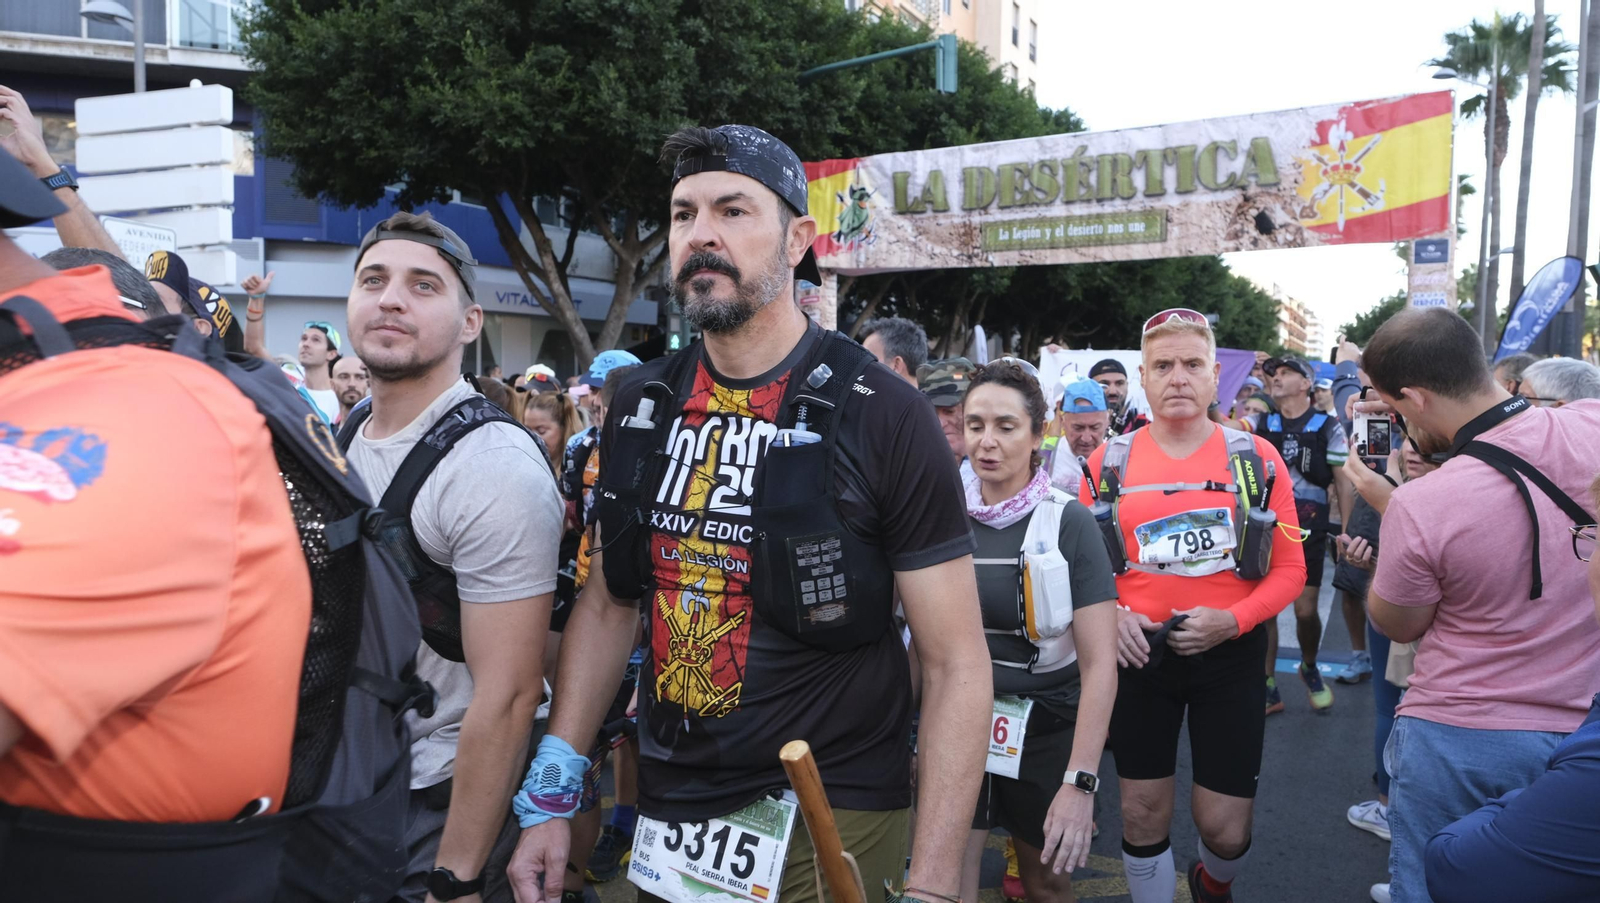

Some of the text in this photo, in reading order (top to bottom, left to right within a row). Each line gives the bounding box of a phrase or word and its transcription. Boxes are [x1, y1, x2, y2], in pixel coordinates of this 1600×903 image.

[892, 136, 1281, 214] LA DESÉRTICA
[126, 229, 172, 242] AVENIDA
[1012, 226, 1041, 241] Legión
[1055, 224, 1064, 237] el
[1067, 222, 1104, 236] desierto
[1107, 222, 1124, 234] nos
[1128, 221, 1146, 232] une
[1503, 398, 1526, 413] SONY
[1244, 460, 1259, 495] AONIJIE
[1167, 529, 1215, 557] 798
[661, 547, 749, 574] LA LEGIÓN
[993, 716, 1009, 744] 6
[638, 850, 651, 862] BUS
[685, 861, 748, 892] PEAL SIERRA IBERA
